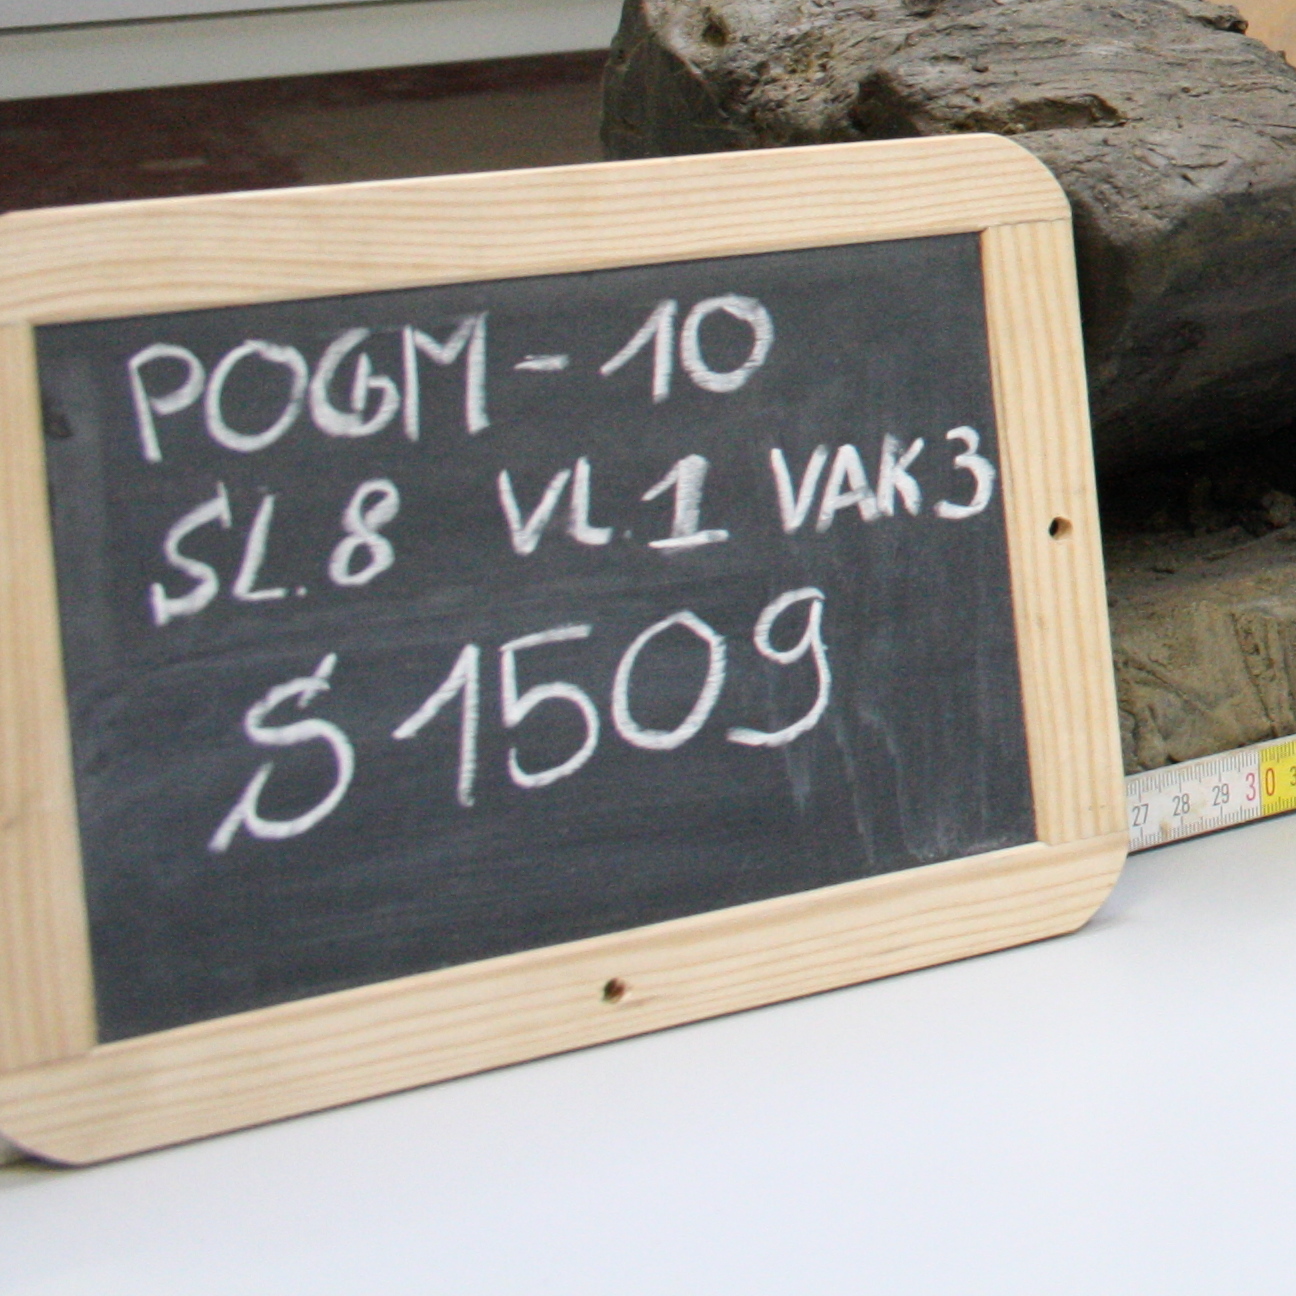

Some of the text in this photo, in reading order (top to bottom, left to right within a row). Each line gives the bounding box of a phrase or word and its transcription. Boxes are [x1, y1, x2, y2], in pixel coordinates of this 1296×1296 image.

[1132, 803, 1149, 827] 27
[1172, 793, 1190, 816] 28
[1212, 783, 1230, 806] 29
